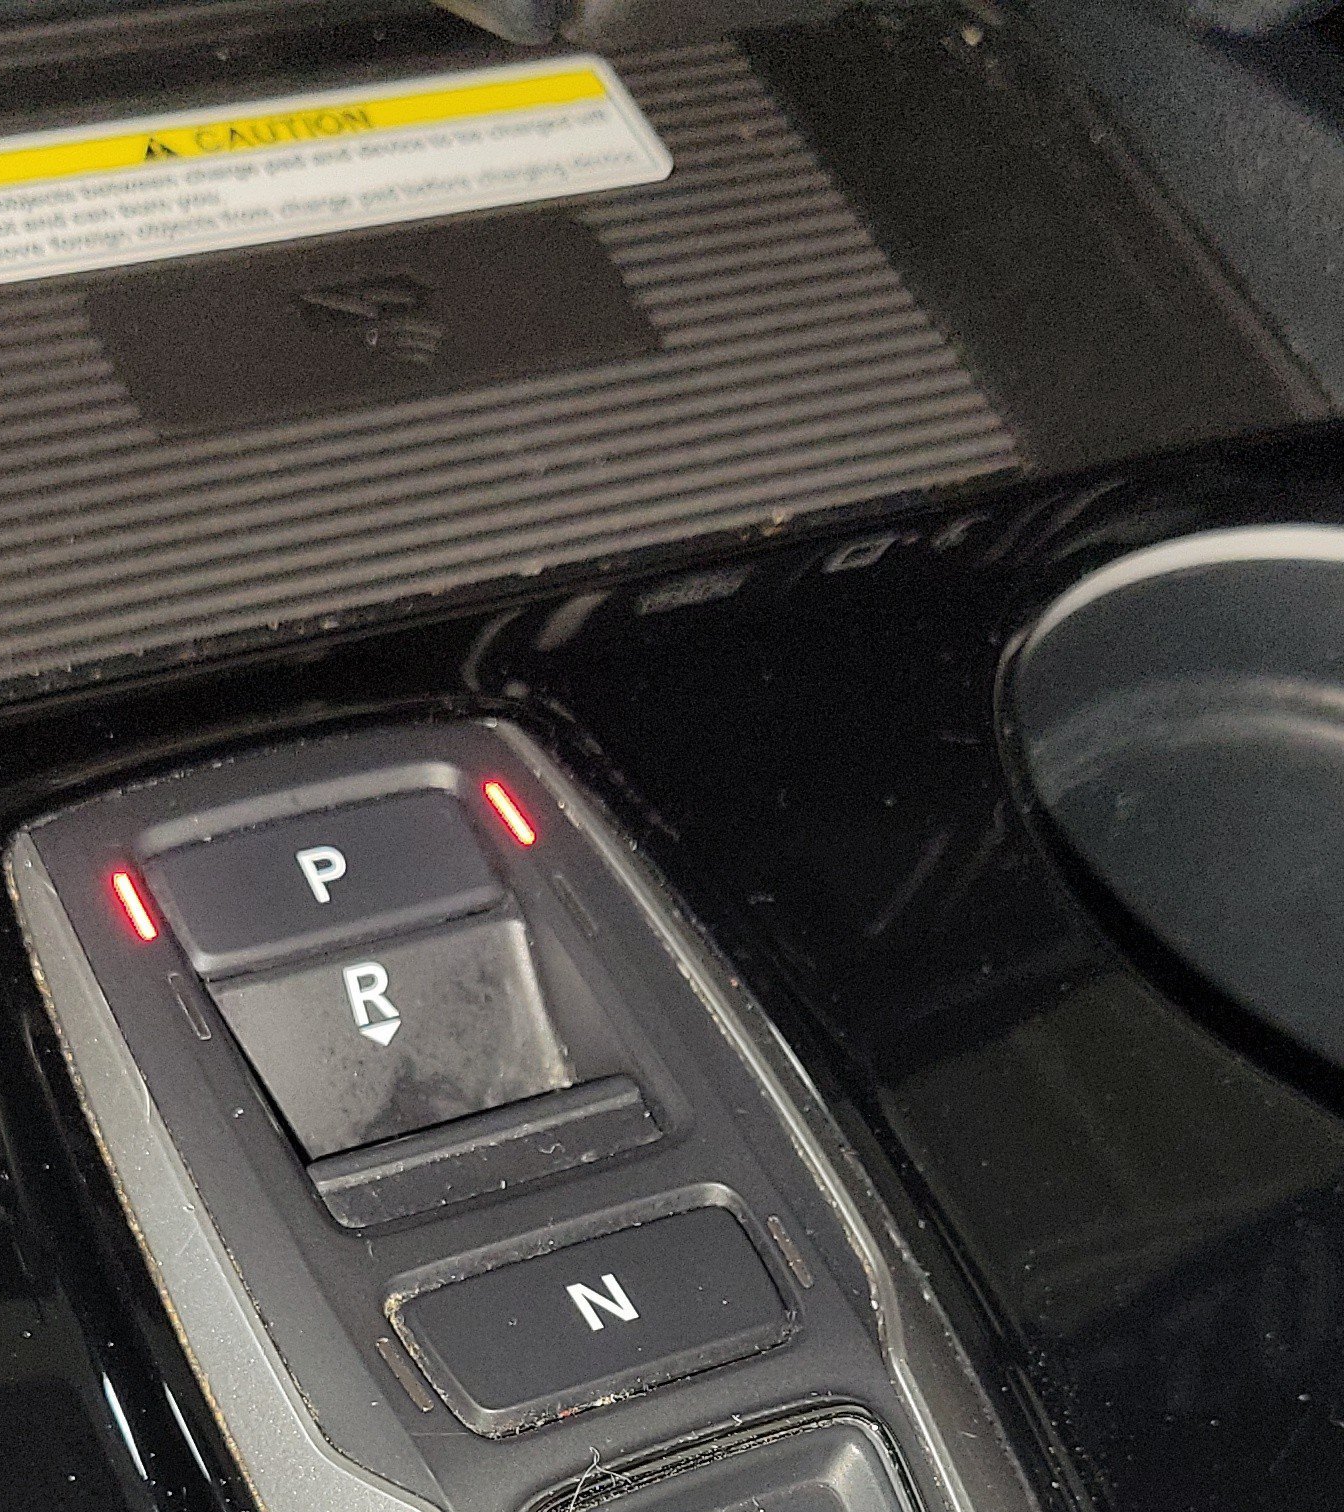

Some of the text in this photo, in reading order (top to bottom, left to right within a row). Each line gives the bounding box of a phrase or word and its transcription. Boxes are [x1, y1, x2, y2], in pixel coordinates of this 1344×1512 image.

[194, 109, 372, 152] CAUTION
[297, 846, 346, 903] P
[343, 961, 400, 1027] R
[567, 1274, 638, 1330] N
